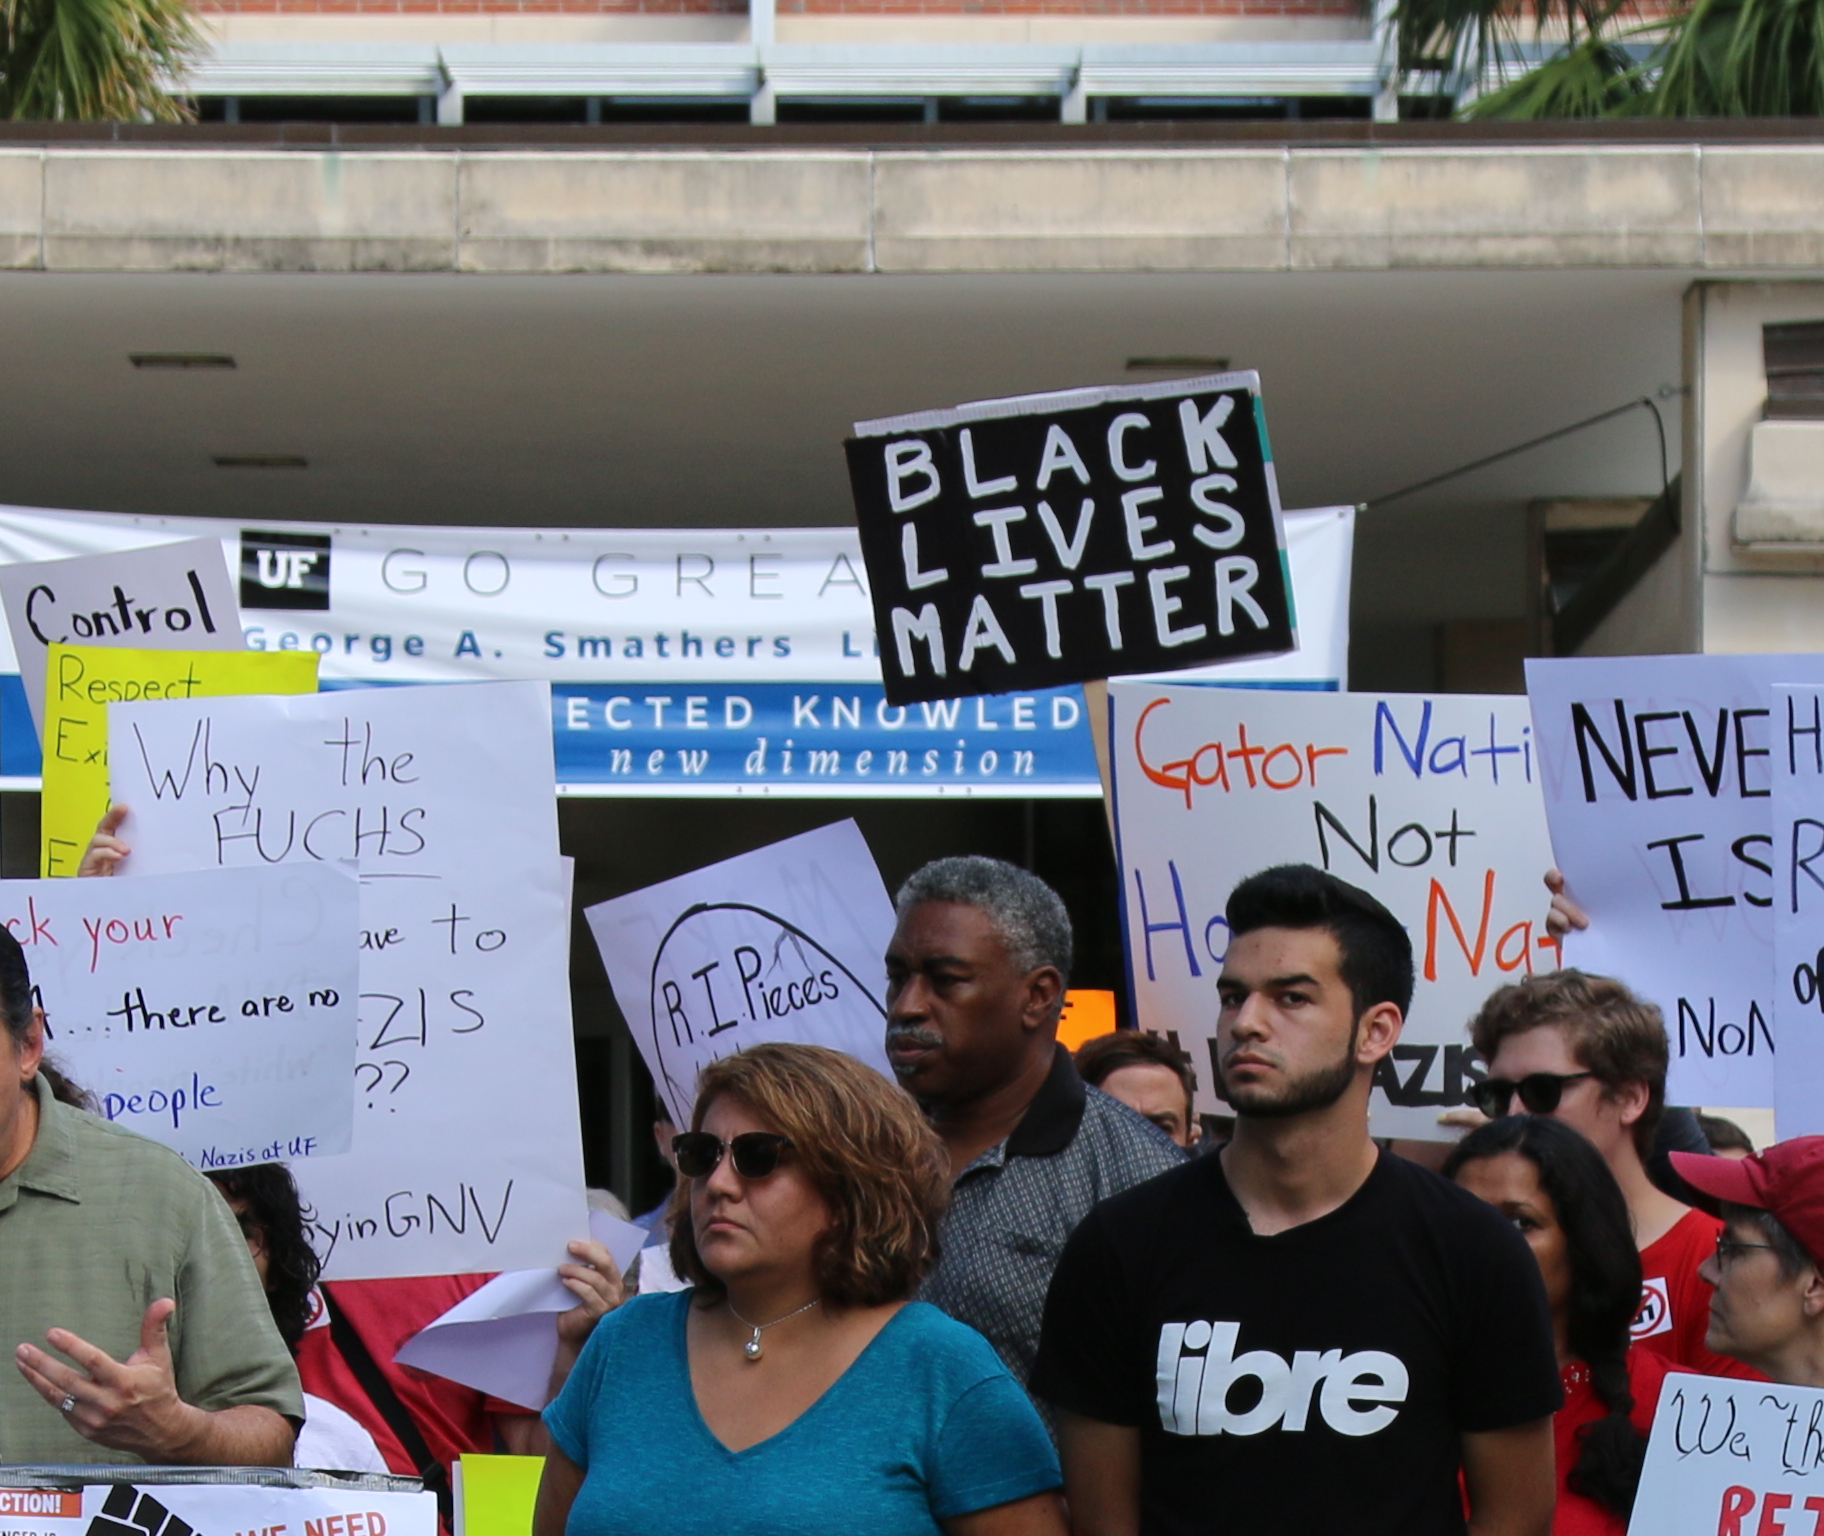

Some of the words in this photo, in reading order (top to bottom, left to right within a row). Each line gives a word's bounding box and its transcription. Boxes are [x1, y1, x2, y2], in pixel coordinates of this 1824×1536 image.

[883, 393, 1238, 515] BLACK
[901, 472, 1247, 591] LIVES
[257, 551, 317, 588] UF
[381, 547, 511, 598] GO
[25, 569, 217, 646] Control
[892, 556, 1270, 678] MATTER
[242, 625, 425, 663] George
[453, 630, 504, 658] A.
[543, 630, 793, 659] Smathers
[133, 716, 260, 826] Why
[324, 716, 421, 787] the
[610, 743, 710, 776] new
[744, 738, 1036, 777] dimension
[1135, 697, 1349, 810] Gator
[213, 804, 428, 866] FUCHS
[1314, 795, 1477, 875] Not
[83, 912, 184, 974] your
[241, 991, 295, 1018] are
[104, 1072, 224, 1129] people
[200, 1147, 256, 1169] Nazis
[262, 1139, 283, 1159] at
[1155, 1319, 1410, 1437] libre
